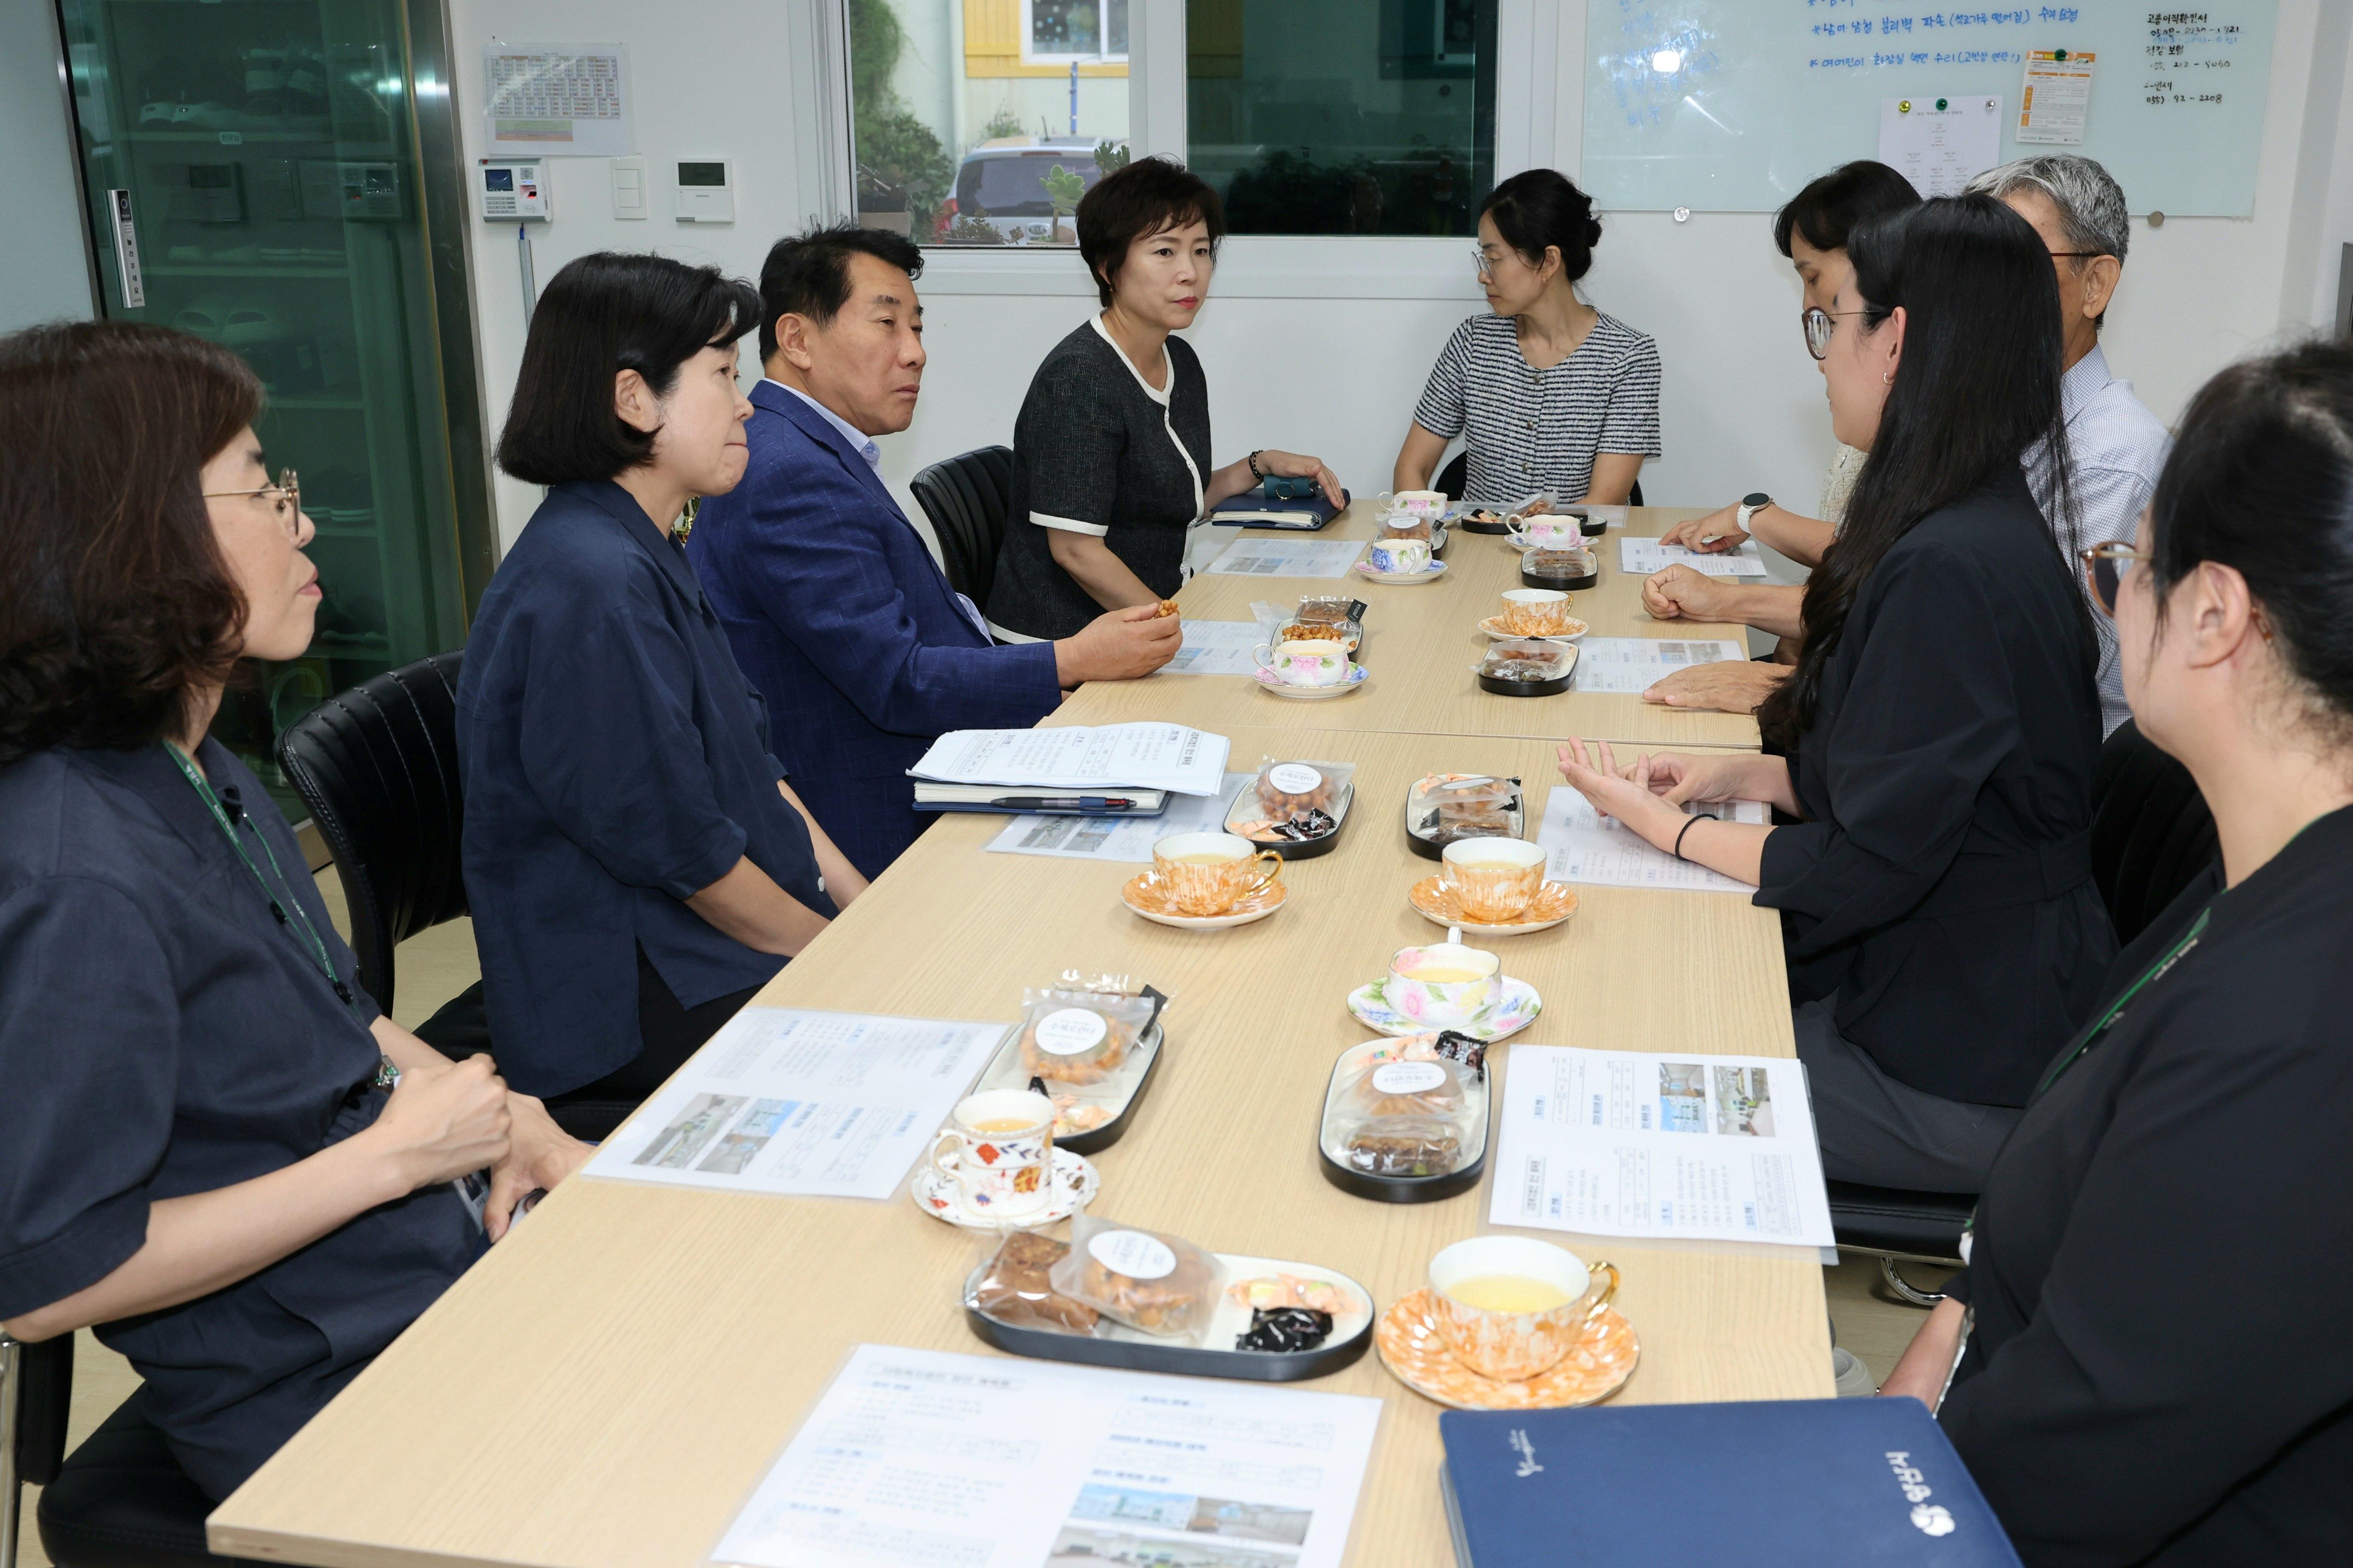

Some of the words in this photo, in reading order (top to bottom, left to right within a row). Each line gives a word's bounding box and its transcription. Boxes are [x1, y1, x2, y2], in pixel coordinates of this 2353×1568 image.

[1882, 16, 1912, 34] 분리벽
[1921, 13, 1946, 28] 파손
[1873, 52, 1904, 66] 화장실
[1934, 52, 1955, 64] 수리
[2199, 93, 2223, 104] 2208
